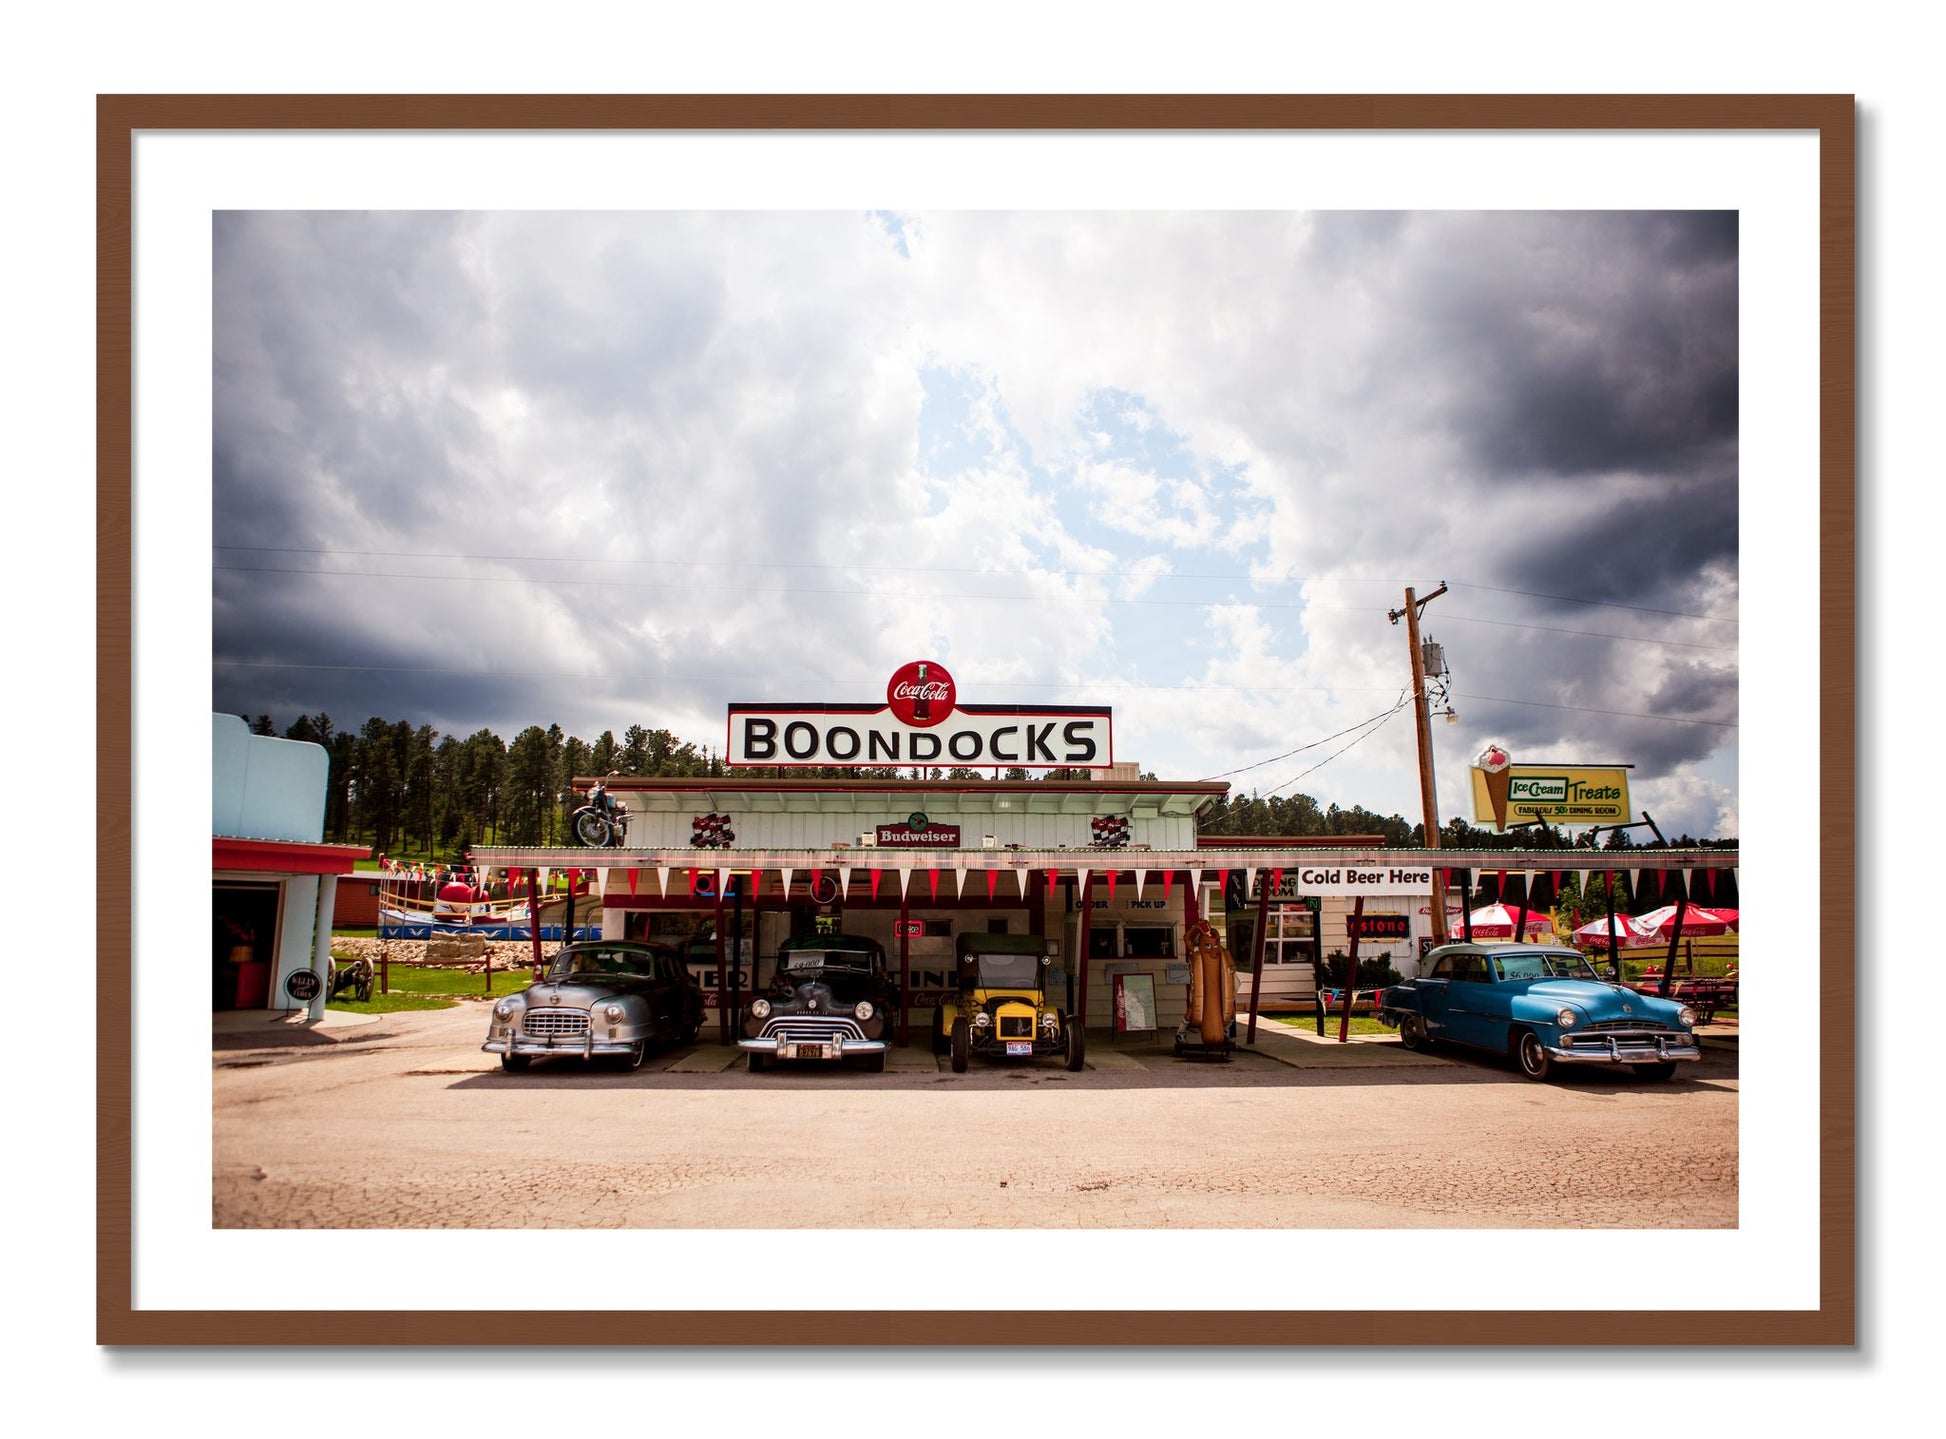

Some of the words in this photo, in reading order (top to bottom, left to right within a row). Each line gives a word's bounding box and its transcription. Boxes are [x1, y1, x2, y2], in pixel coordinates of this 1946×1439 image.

[893, 680, 950, 701] Coca-Cola
[743, 718, 1097, 761] BOONDOCKS
[1513, 782, 1529, 794] Ice
[1529, 782, 1564, 797] Cream
[1569, 781, 1621, 802] Treats
[1518, 806, 1552, 814] FABULOUS
[1569, 806, 1593, 815] DINING
[1595, 806, 1616, 815] ROOM
[880, 830, 956, 842] Budweiser
[1302, 870, 1340, 884] Cold
[1346, 870, 1384, 884] Beer
[1389, 870, 1430, 884] Here
[1076, 901, 1109, 909] ODER
[1131, 901, 1152, 909] PICK
[1154, 901, 1166, 909] UP
